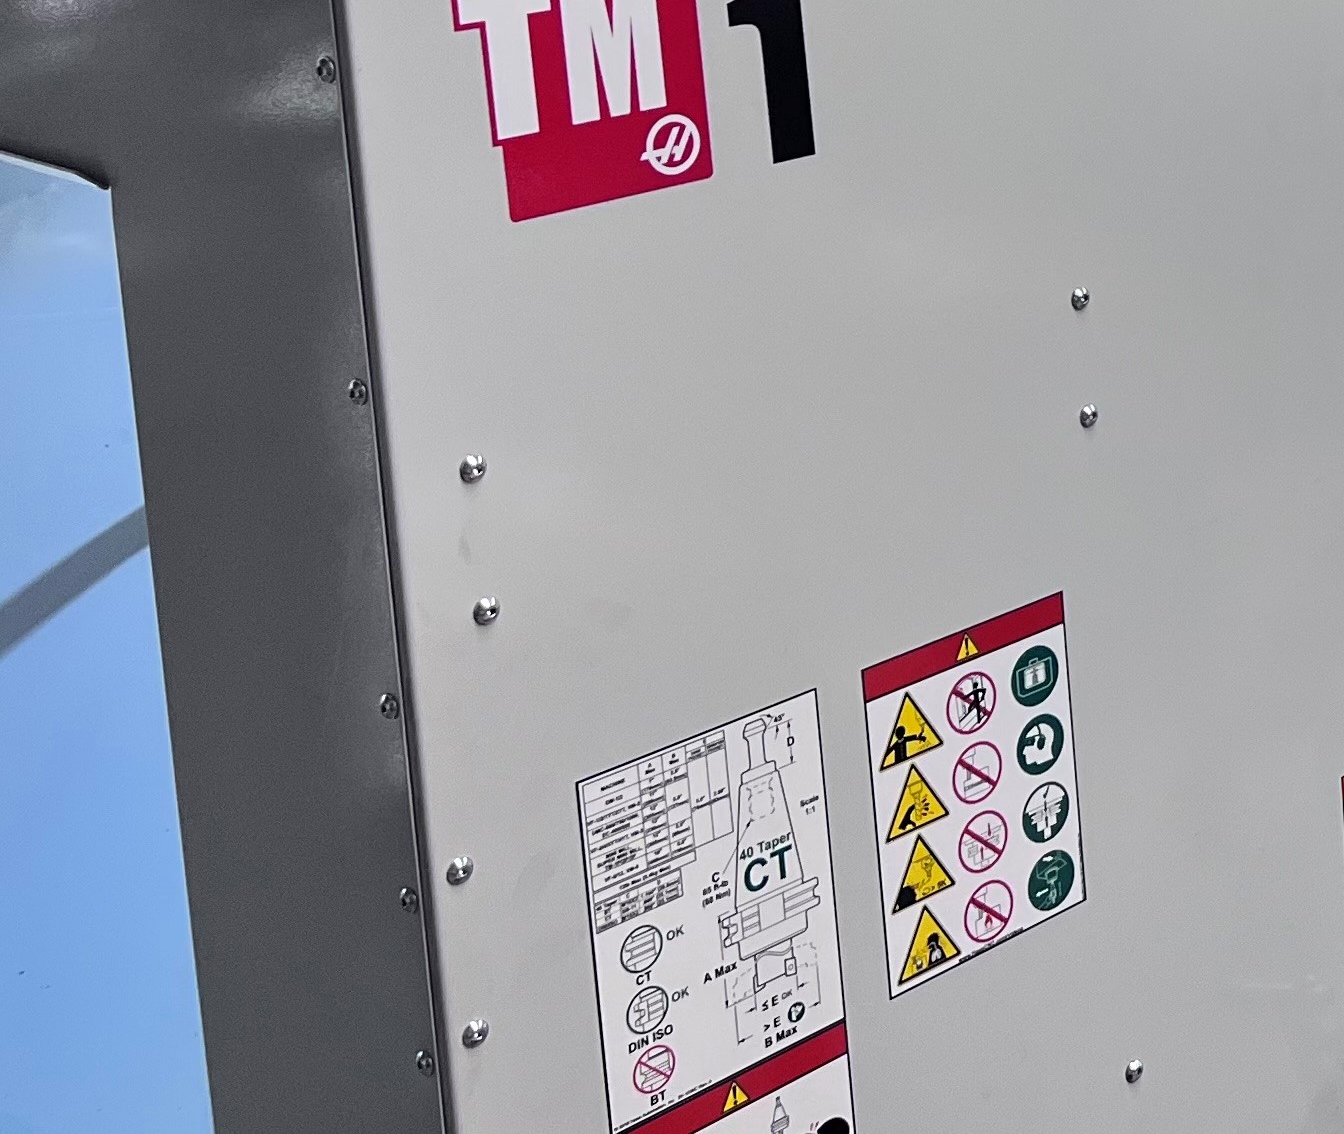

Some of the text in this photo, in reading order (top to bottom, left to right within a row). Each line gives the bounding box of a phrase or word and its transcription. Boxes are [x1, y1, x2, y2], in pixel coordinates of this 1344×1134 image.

[787, 736, 795, 748] D
[800, 795, 819, 807] Scale
[739, 832, 791, 861] 40 Taper
[744, 843, 793, 892] CT
[711, 872, 720, 882] C
[666, 924, 685, 941] OK
[635, 970, 653, 986] CT
[703, 961, 738, 984] A Max
[671, 986, 690, 1003] OK
[771, 995, 779, 1007] E
[773, 1016, 782, 1028] E
[628, 1023, 674, 1054] DIN ISO
[764, 1025, 798, 1048] B Max
[650, 1089, 667, 1107] BT
